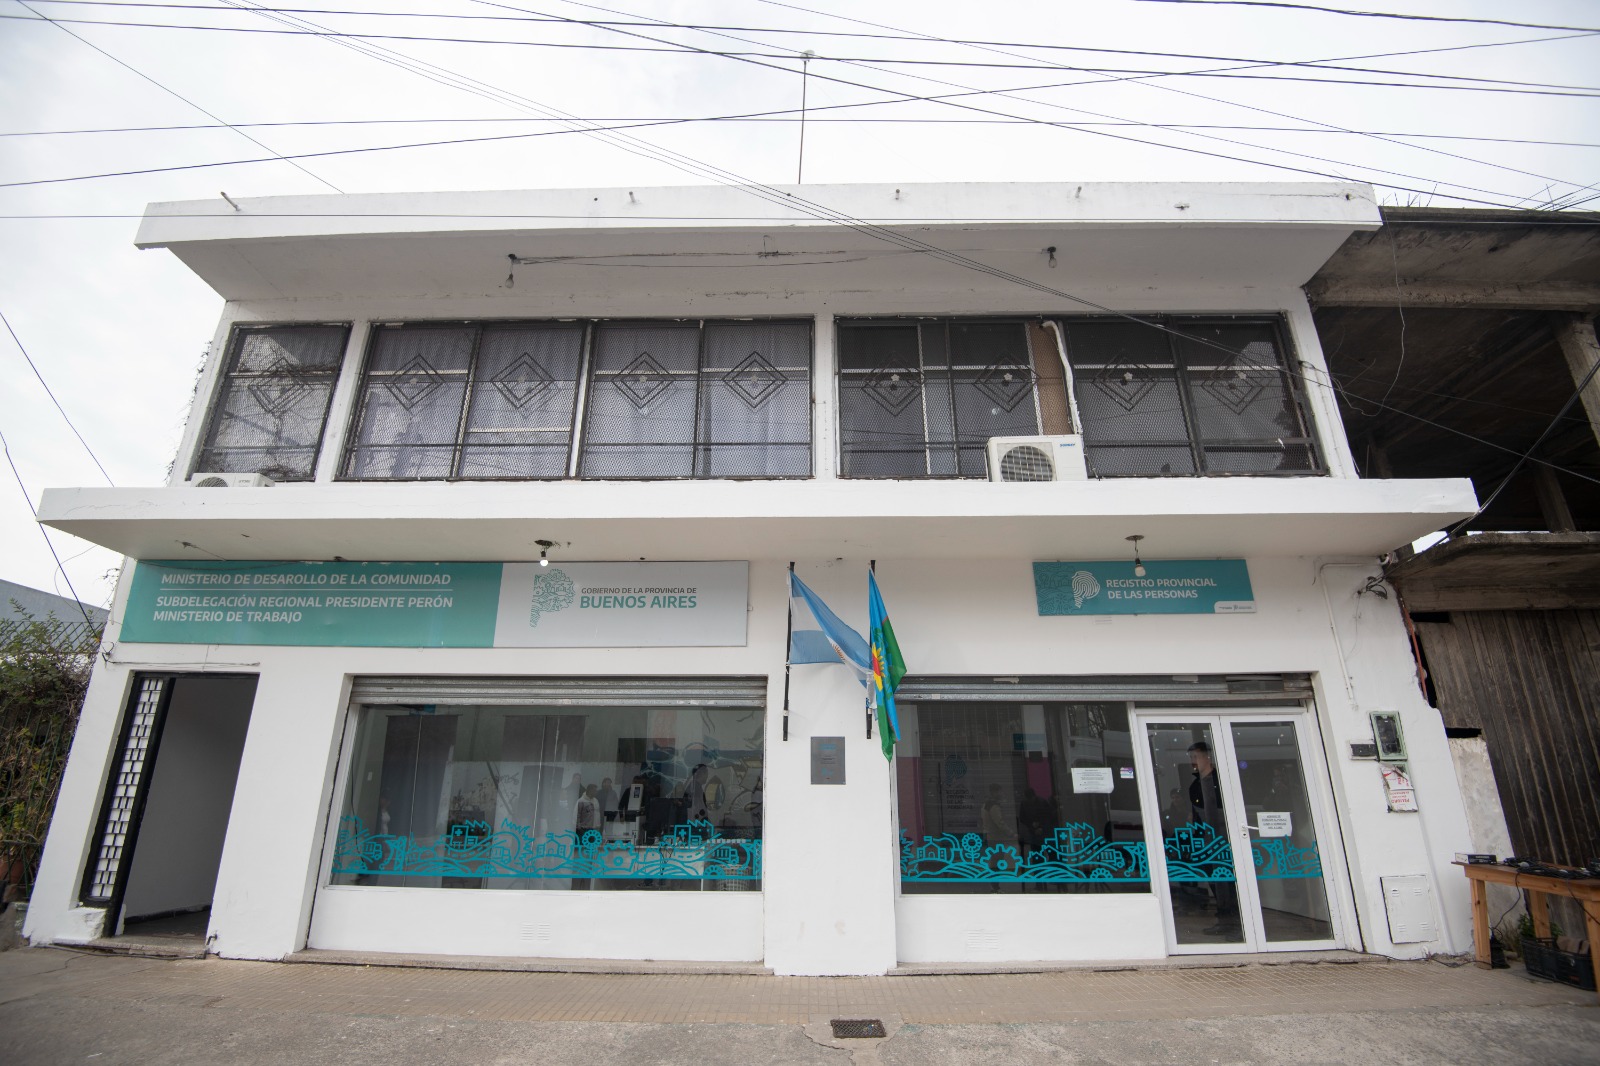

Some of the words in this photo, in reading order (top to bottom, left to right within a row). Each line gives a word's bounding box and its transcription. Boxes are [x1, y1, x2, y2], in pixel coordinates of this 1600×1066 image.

[161, 574, 231, 584] MINISTERIO
[233, 574, 251, 584] DE
[253, 574, 327, 585] DESAROLLO
[330, 574, 348, 585] DE
[350, 574, 367, 585] LA
[370, 574, 451, 585] COMUNIDAD
[1105, 579, 1155, 588] REGISTRO
[1157, 578, 1217, 587] PROVINCIAL
[1107, 590, 1122, 599] DE
[1123, 590, 1143, 599] LAS
[1145, 589, 1198, 599] PERSONAS
[156, 594, 256, 607] SUBDELEGACIÓN
[259, 597, 322, 608] REGIONAL
[325, 597, 405, 608] PRESIDENTE
[408, 594, 453, 608] PERÓN
[580, 595, 646, 609] BUENOS
[650, 595, 697, 609] AIRES
[153, 611, 224, 622] MINISTERIO
[226, 611, 243, 622] DE
[246, 611, 302, 624] TRABAJO
